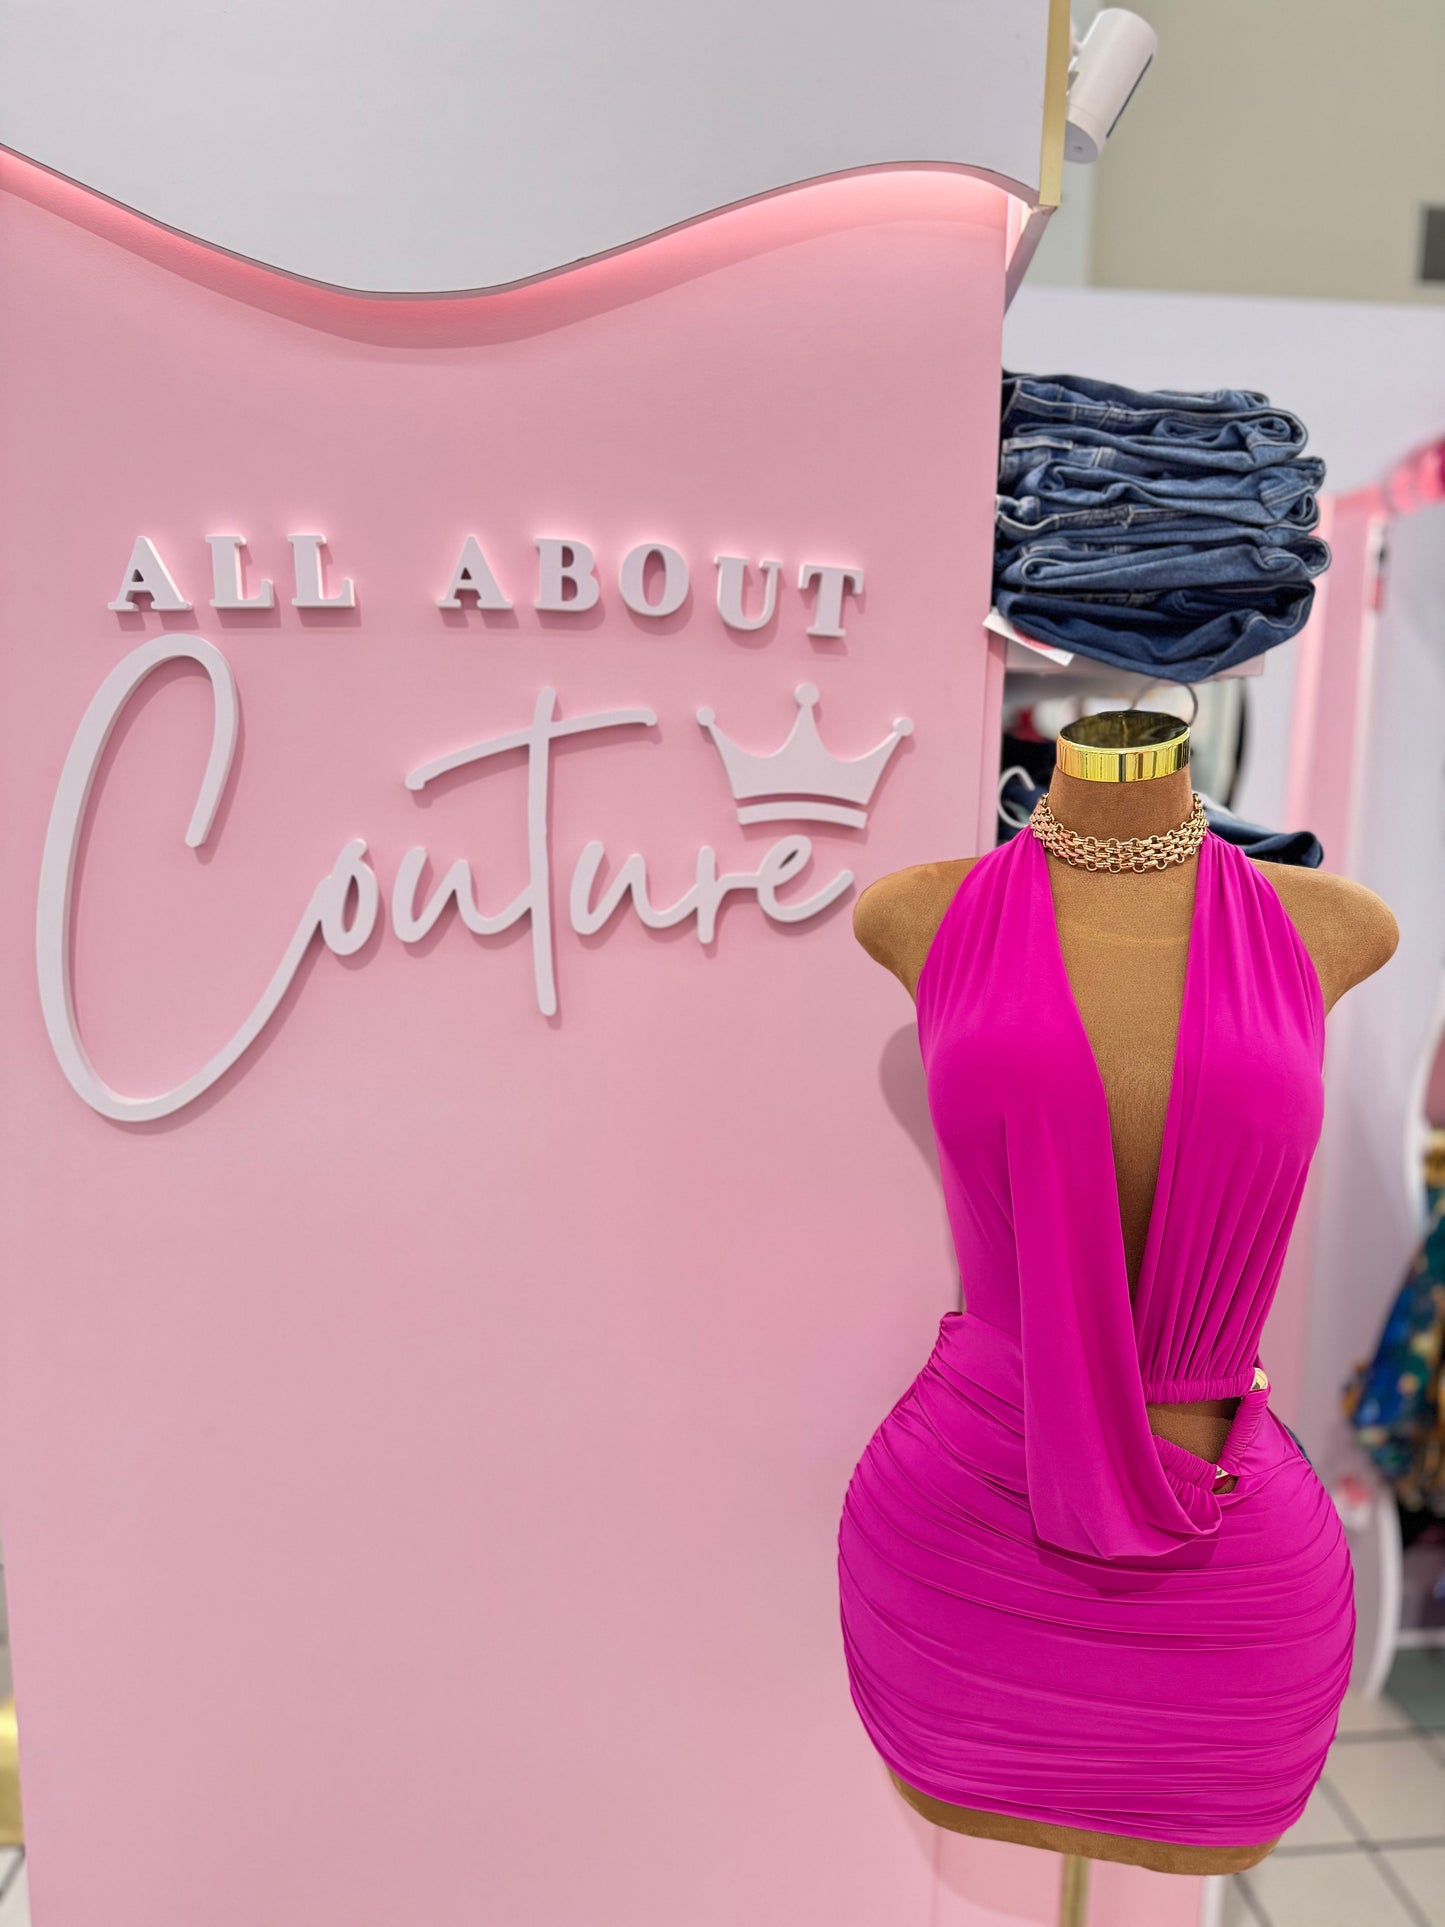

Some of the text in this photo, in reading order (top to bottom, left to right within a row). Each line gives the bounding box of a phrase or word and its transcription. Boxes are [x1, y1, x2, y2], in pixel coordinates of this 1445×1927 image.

[108, 534, 865, 638] ALL ABOUT
[36, 633, 855, 1122] Couture
